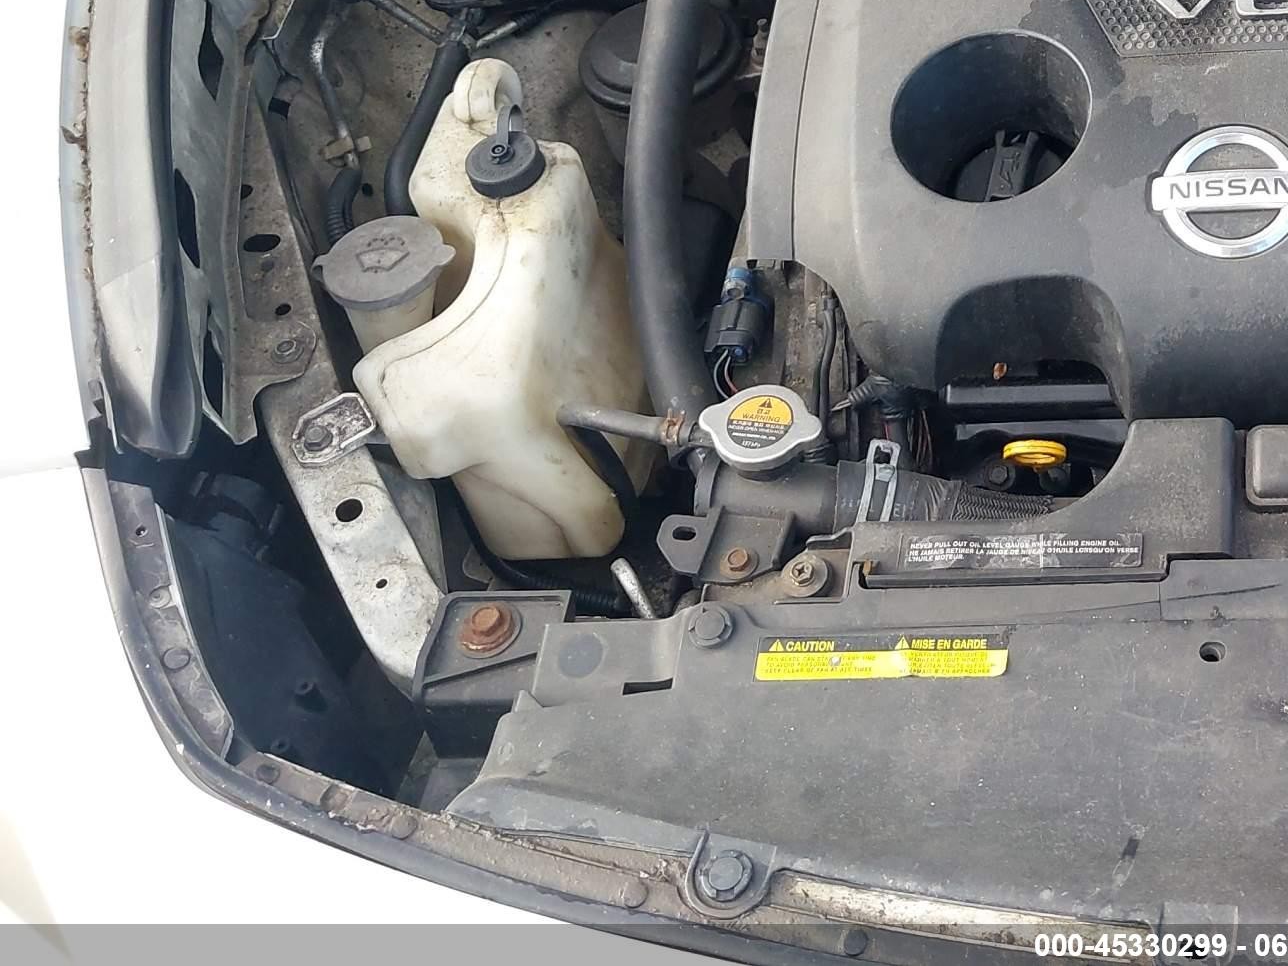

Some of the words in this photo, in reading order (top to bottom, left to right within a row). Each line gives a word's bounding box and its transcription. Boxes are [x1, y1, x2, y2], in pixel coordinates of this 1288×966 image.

[742, 412, 781, 423] WARNING
[969, 540, 981, 548] OIL
[785, 641, 835, 652] CAUTION
[911, 638, 935, 650] MISE
[937, 638, 951, 650] EN
[952, 638, 988, 649] GARDE
